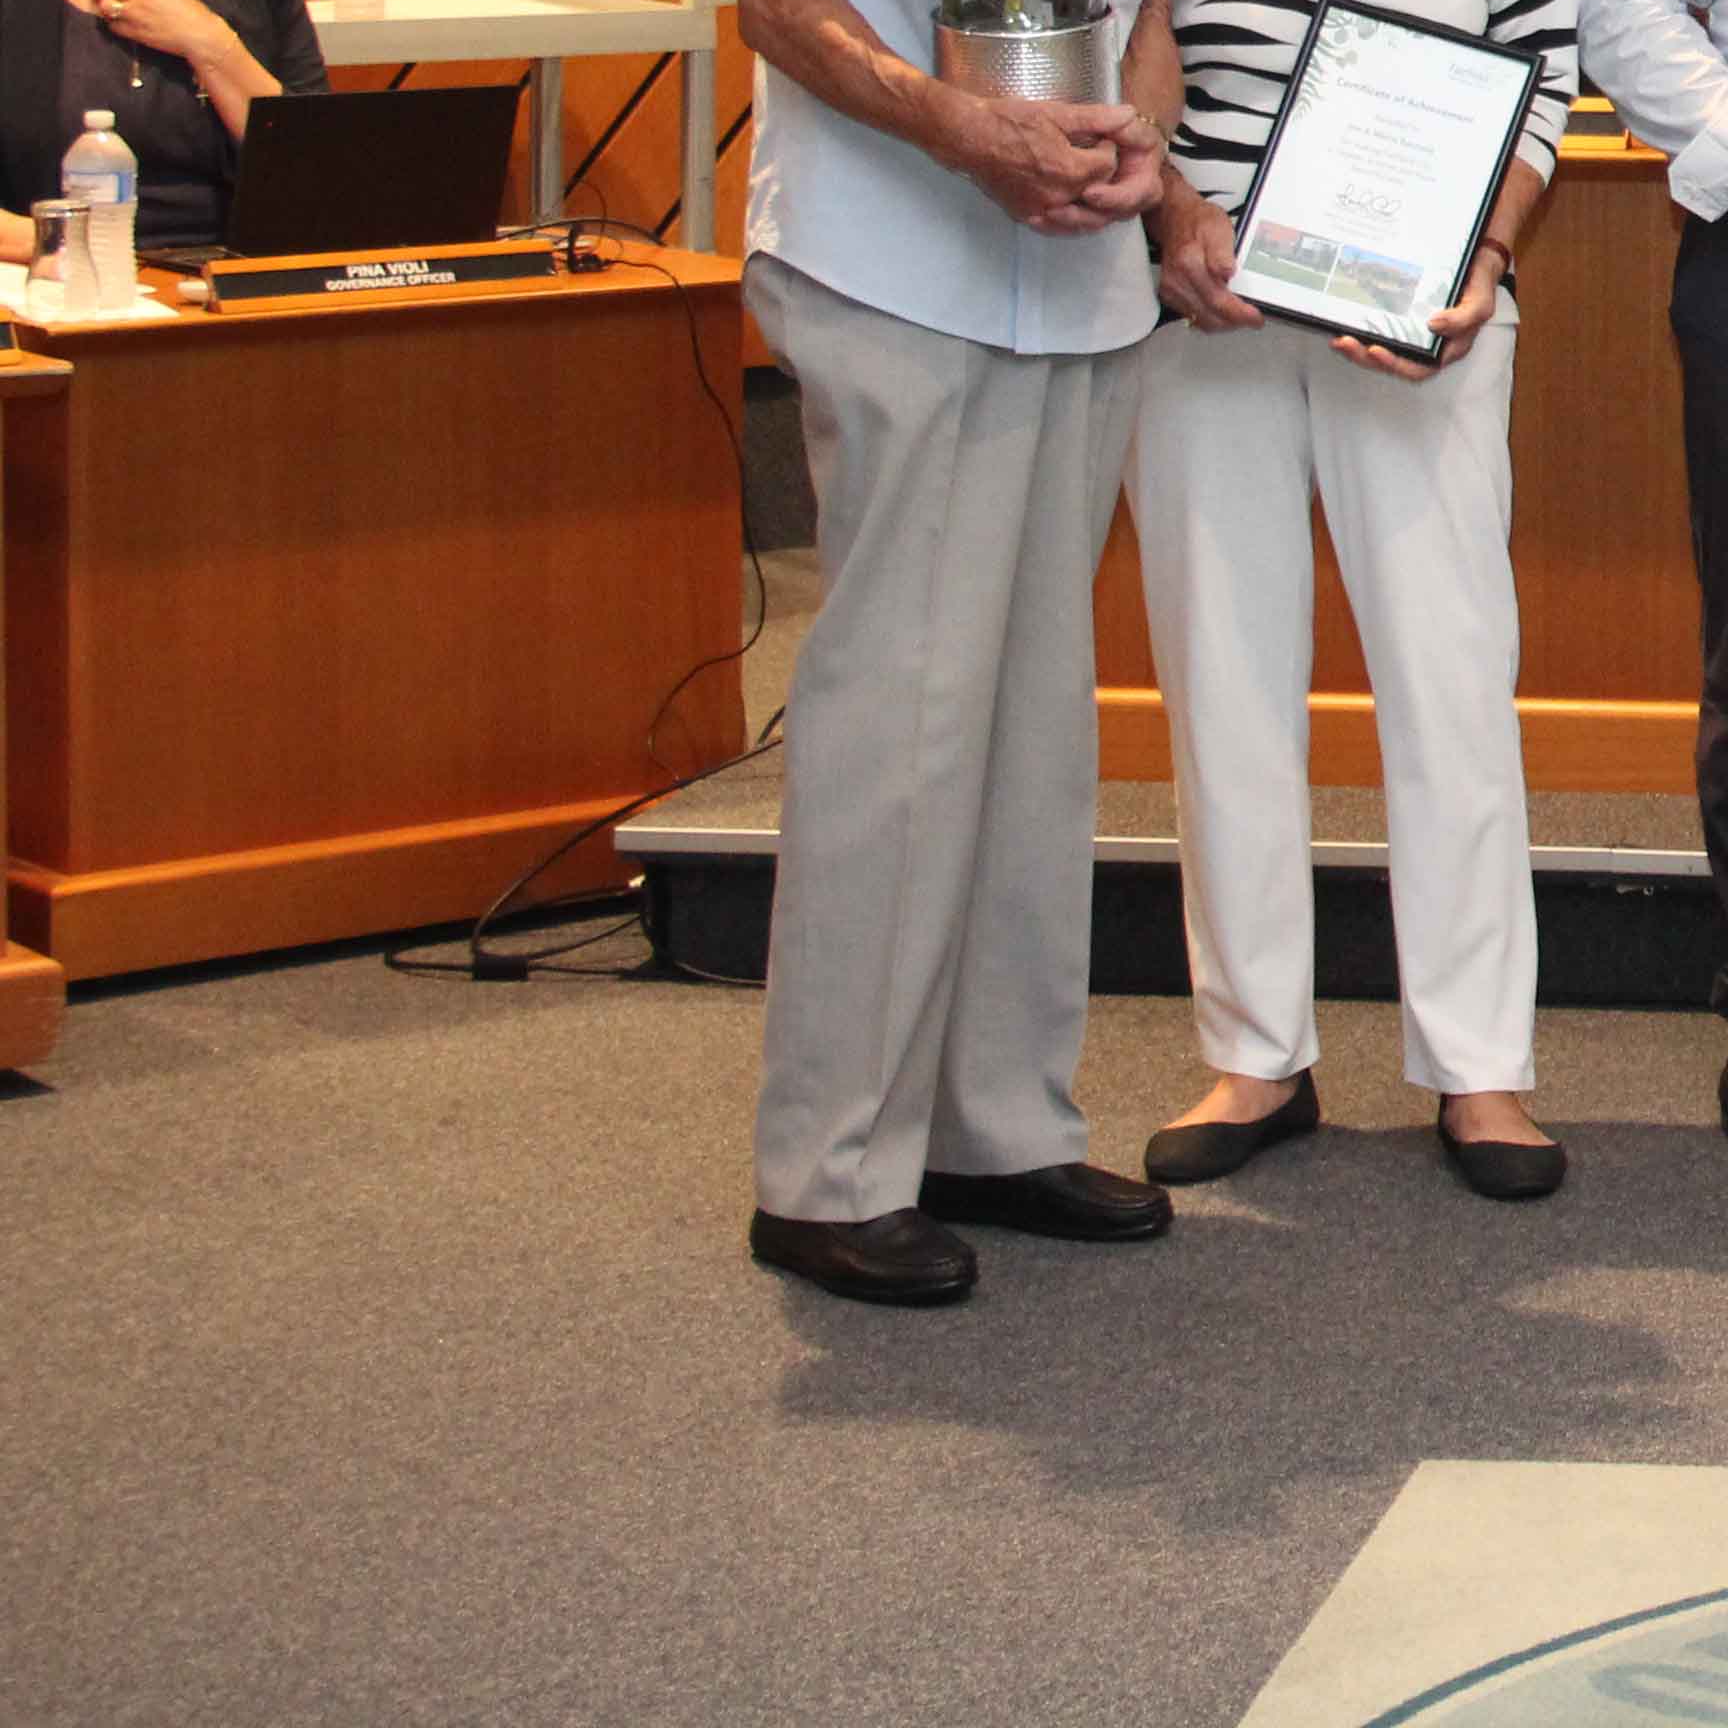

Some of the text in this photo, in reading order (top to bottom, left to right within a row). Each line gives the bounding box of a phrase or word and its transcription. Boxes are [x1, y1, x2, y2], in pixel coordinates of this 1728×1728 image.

[346, 260, 429, 278] PINA VIOLI
[325, 271, 456, 292] GOVERNANCE OFFICER
